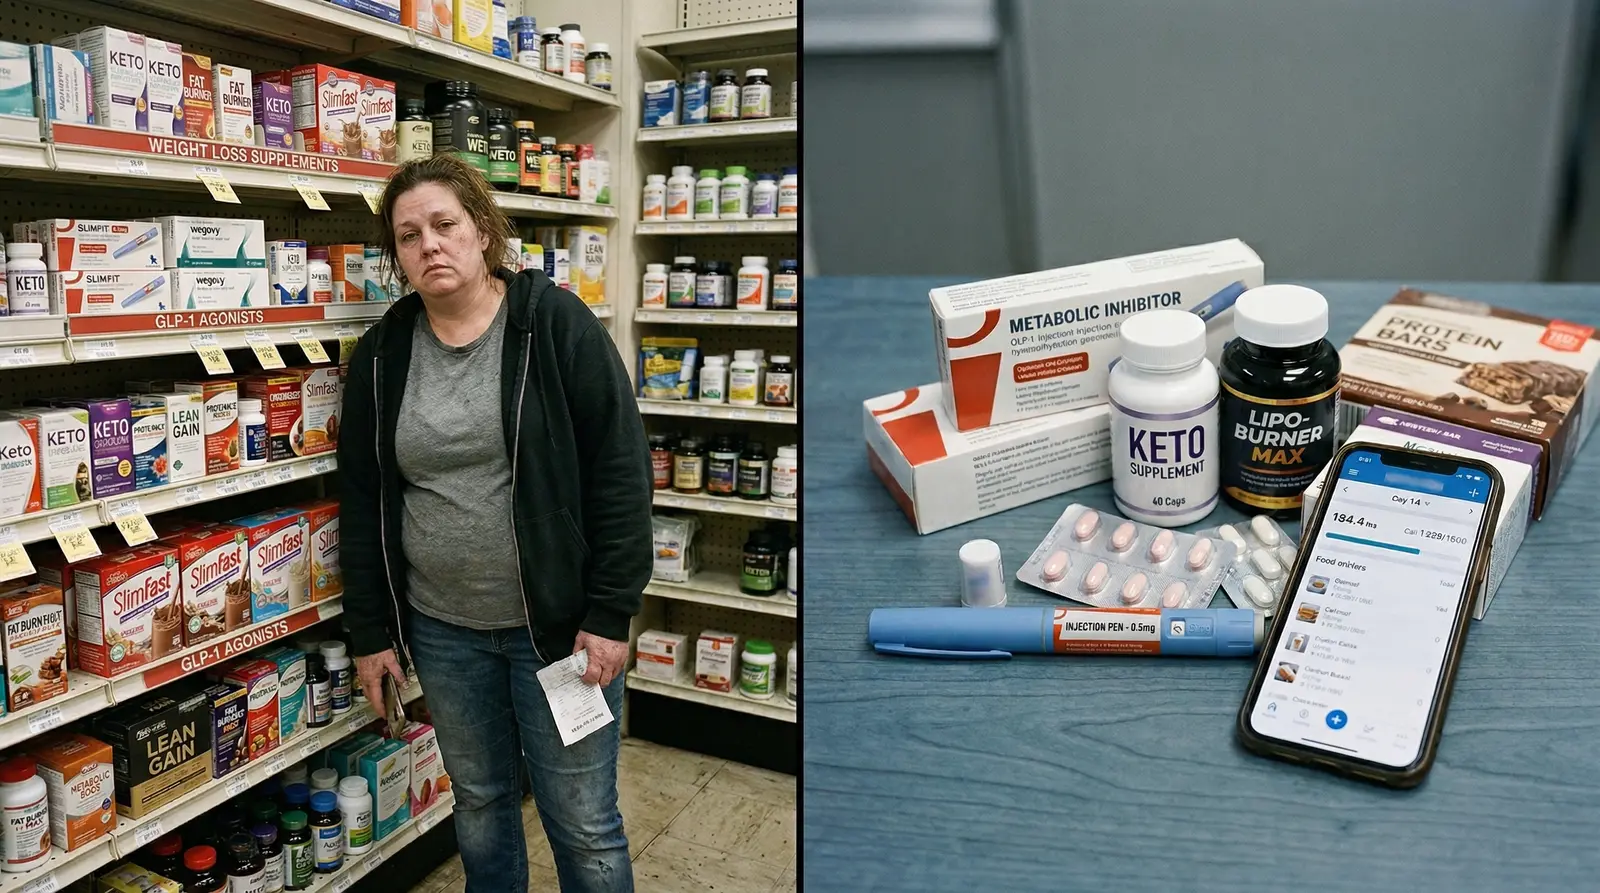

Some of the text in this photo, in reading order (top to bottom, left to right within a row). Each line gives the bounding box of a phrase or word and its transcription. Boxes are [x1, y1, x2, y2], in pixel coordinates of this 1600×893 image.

[109, 50, 144, 70] KETO
[148, 60, 181, 79] KETO
[189, 74, 205, 88] FAT
[229, 81, 245, 96] FAT
[265, 97, 291, 115] KETO
[148, 137, 340, 174] WEIGHT LOSS SUPPLEMENTS
[190, 225, 221, 238] wegovy
[16, 276, 45, 291] KETO
[196, 276, 226, 287] wegovy
[155, 309, 265, 329] GLP-1 AGONISTS
[1009, 291, 1182, 333] METABOLIC INHIBITOR
[1376, 328, 1450, 352] BARS
[1385, 316, 1504, 351] PROTEIN
[172, 409, 200, 424] LEAN
[1248, 409, 1310, 428] LIPO-
[48, 428, 86, 447] KETO
[94, 418, 129, 440] KETO
[173, 425, 200, 439] GAIN
[1234, 422, 1323, 447] BURNER
[0, 446, 33, 460] Keto
[1129, 425, 1205, 464] KETO
[1251, 446, 1306, 465] MAX
[1130, 459, 1205, 480] SUPPLEMENT
[1152, 497, 1163, 506] 40
[1409, 497, 1421, 507] 14
[1315, 555, 1336, 567] Food
[7, 621, 20, 636] FAT
[20, 616, 43, 633] BURN
[1065, 622, 1106, 632] INJECTION
[1107, 622, 1124, 632] PEN
[1130, 622, 1156, 634] 0.5mg
[180, 620, 290, 673] GLP-1 AGONISTS
[147, 722, 195, 758] LEAN
[148, 740, 195, 776] GAIN
[70, 770, 110, 795] METABOLIC
[11, 814, 26, 826] FAT
